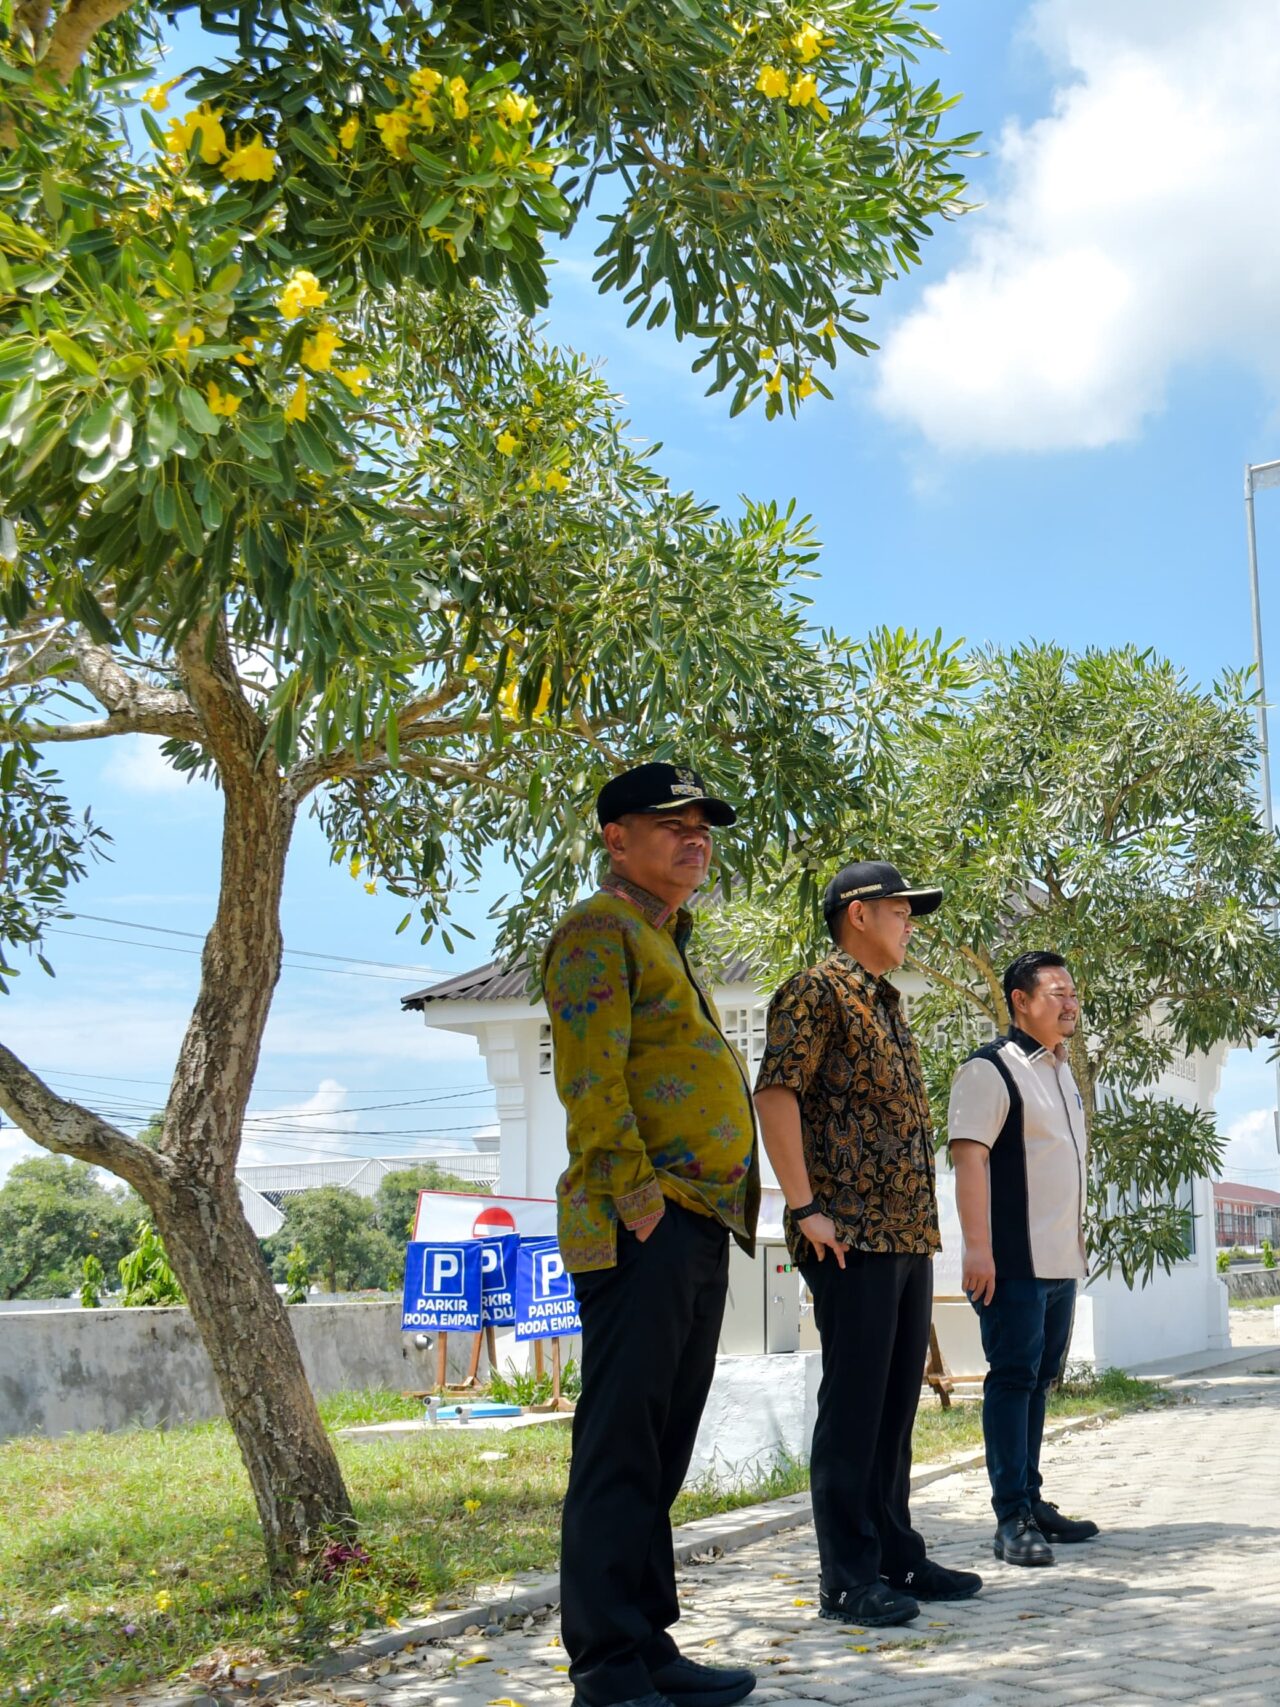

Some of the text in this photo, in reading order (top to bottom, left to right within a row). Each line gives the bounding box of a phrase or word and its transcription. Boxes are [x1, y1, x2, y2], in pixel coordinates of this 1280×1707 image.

[433, 1253, 459, 1291] P
[541, 1253, 564, 1296] P
[416, 1299, 468, 1312] PARKIR
[482, 1292, 512, 1307] RKIR
[493, 1306, 516, 1320] DU
[528, 1300, 576, 1319] PARKIR
[404, 1313, 438, 1325] RODA
[440, 1313, 479, 1326] EMPAT
[517, 1314, 582, 1336] RODA EMPA
